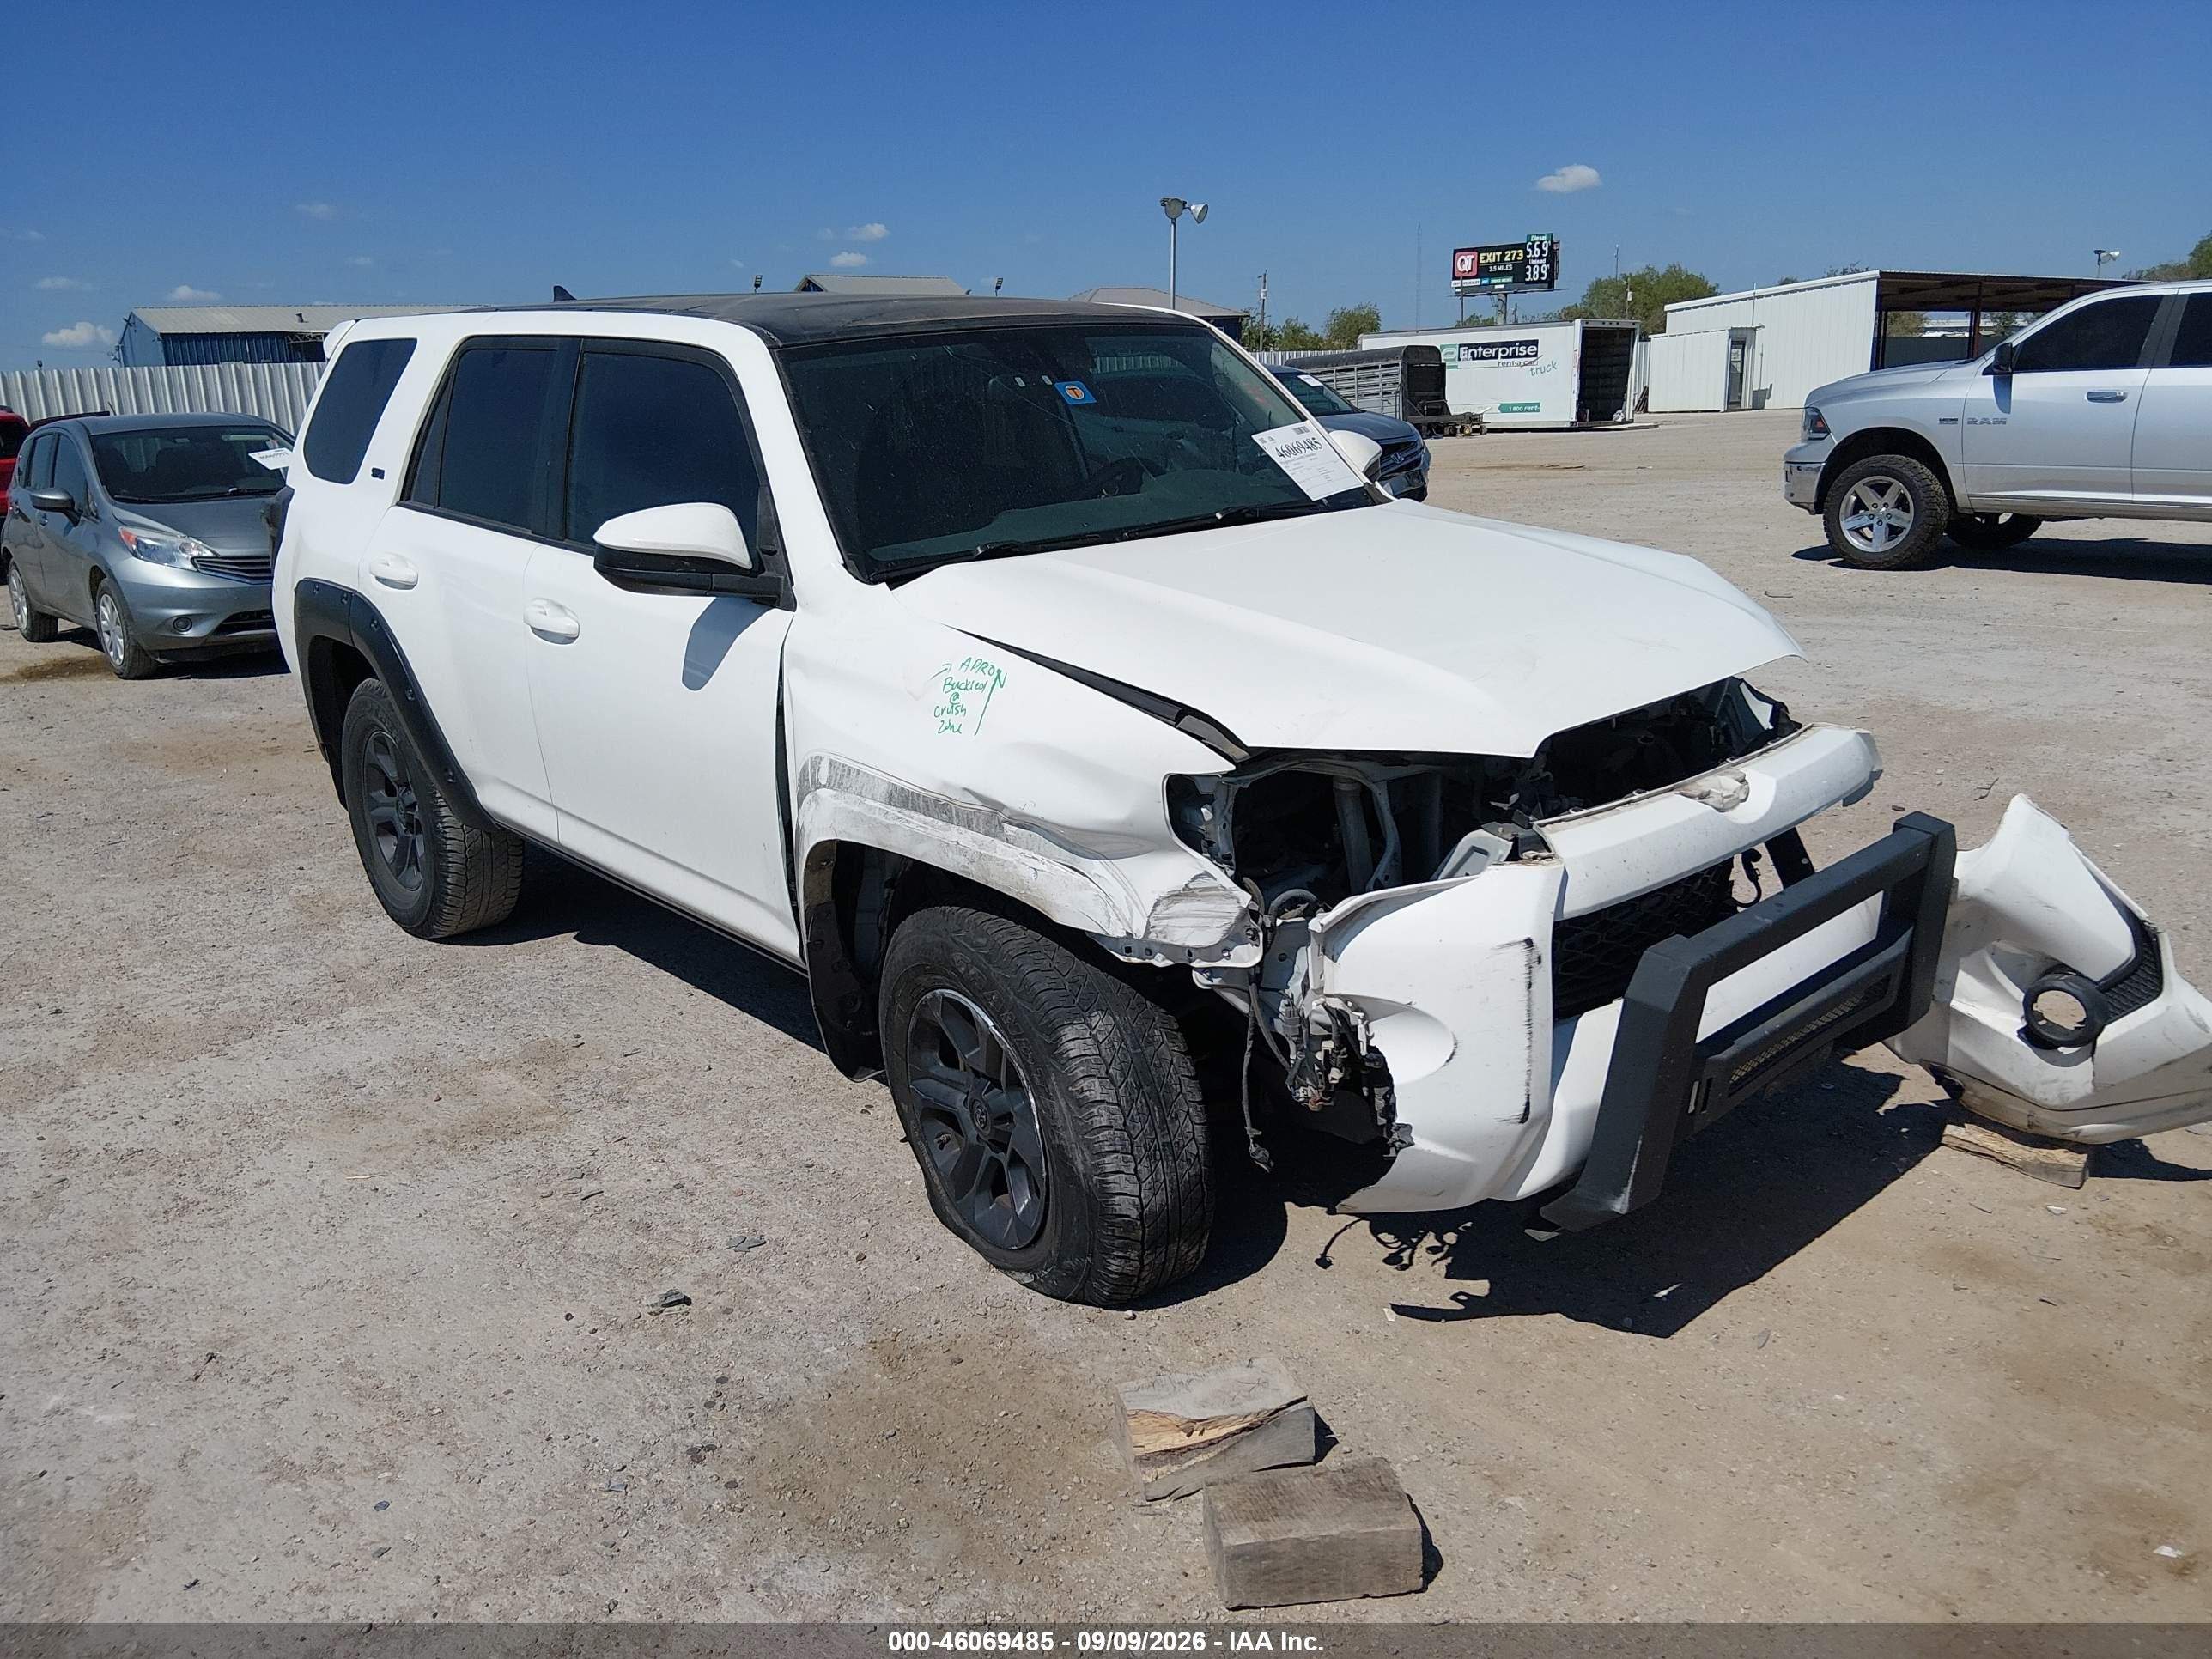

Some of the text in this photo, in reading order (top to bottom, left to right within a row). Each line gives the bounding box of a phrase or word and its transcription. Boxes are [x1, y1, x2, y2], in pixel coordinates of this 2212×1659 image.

[1457, 254, 1474, 272] QT
[1480, 249, 1524, 263] EXIT 273
[1460, 343, 1537, 359] Enterprise
[1530, 361, 1558, 376] truck
[1274, 437, 1323, 459] 46069485
